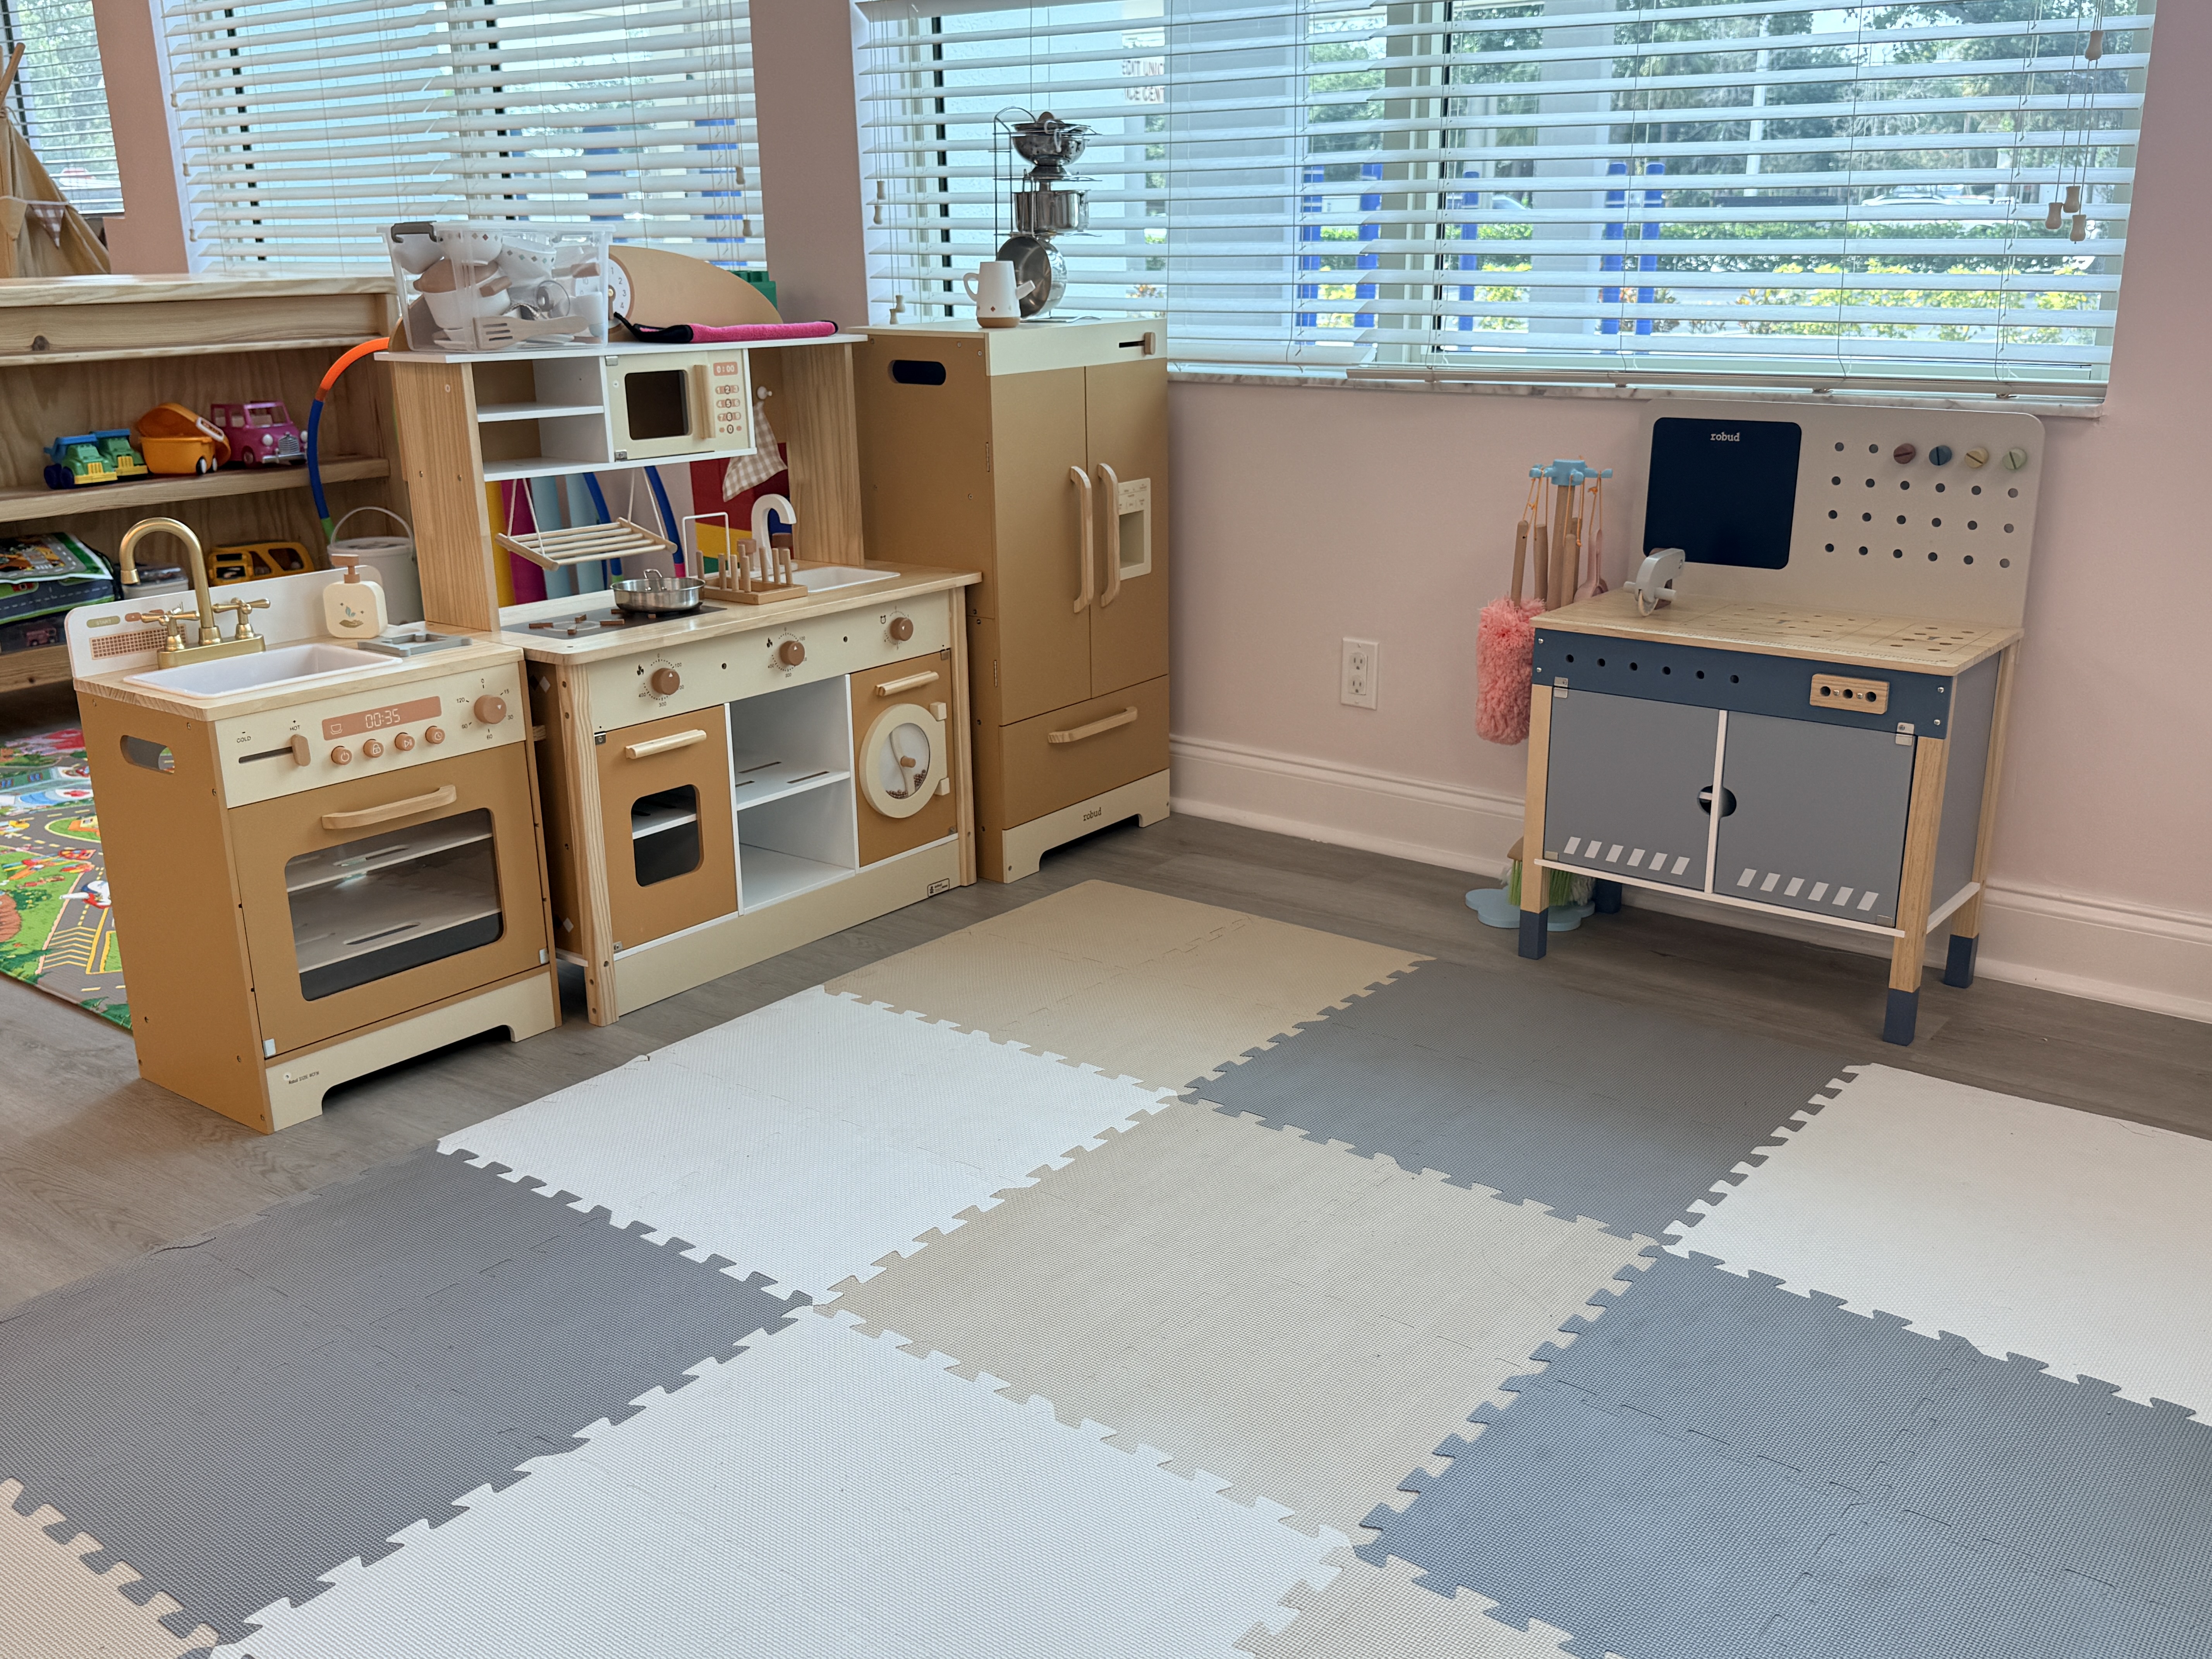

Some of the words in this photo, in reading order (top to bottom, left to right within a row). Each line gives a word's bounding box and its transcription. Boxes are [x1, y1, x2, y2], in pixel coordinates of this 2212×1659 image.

[716, 365, 735, 373] 0:00
[1710, 431, 1740, 442] robud
[365, 708, 400, 728] 00:35
[1083, 807, 1102, 821] robud
